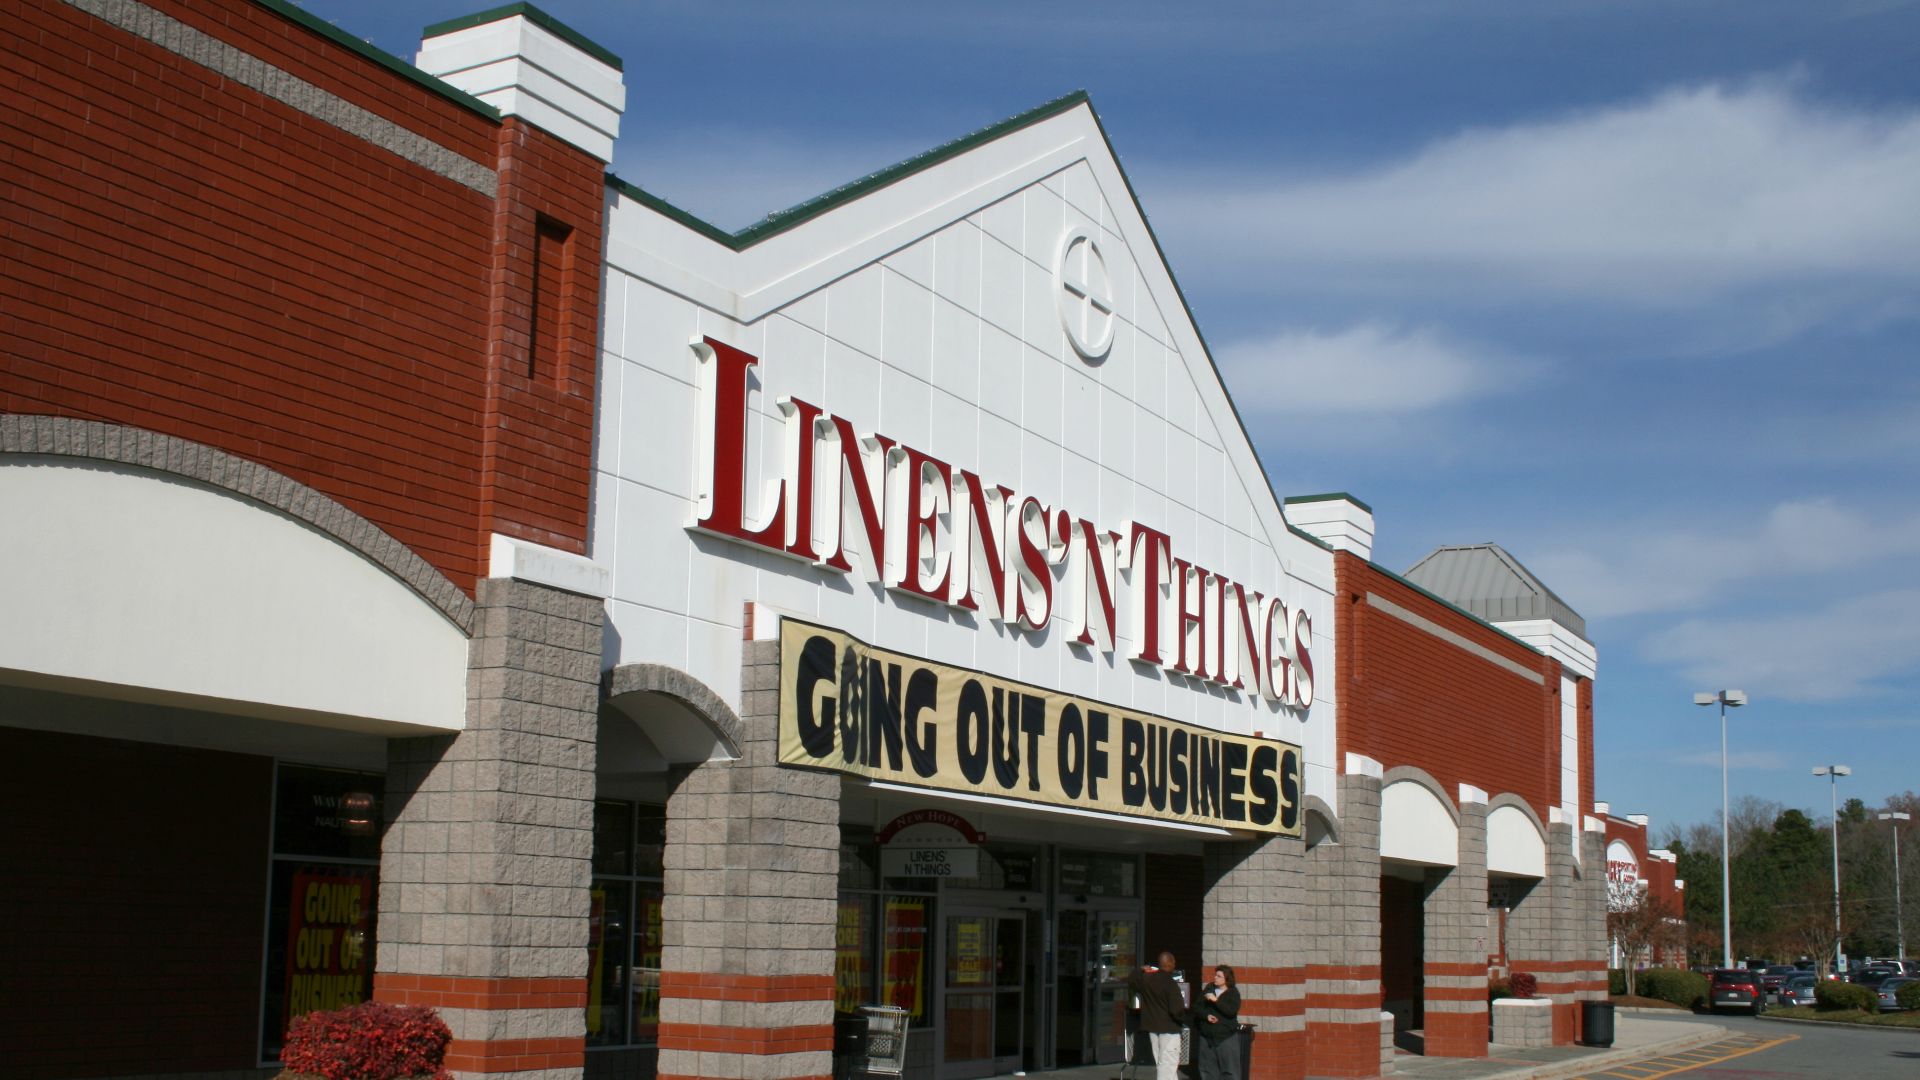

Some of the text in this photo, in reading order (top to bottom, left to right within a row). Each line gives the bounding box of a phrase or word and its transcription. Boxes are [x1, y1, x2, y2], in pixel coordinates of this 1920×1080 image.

[1118, 520, 1315, 710] THINGS
[796, 635, 1299, 829] GOING OUT OF BUSINESS
[896, 811, 961, 828] NEW HOPE
[914, 863, 951, 876] THINGS
[305, 881, 361, 925] GOING
[296, 927, 365, 969] OUT OF
